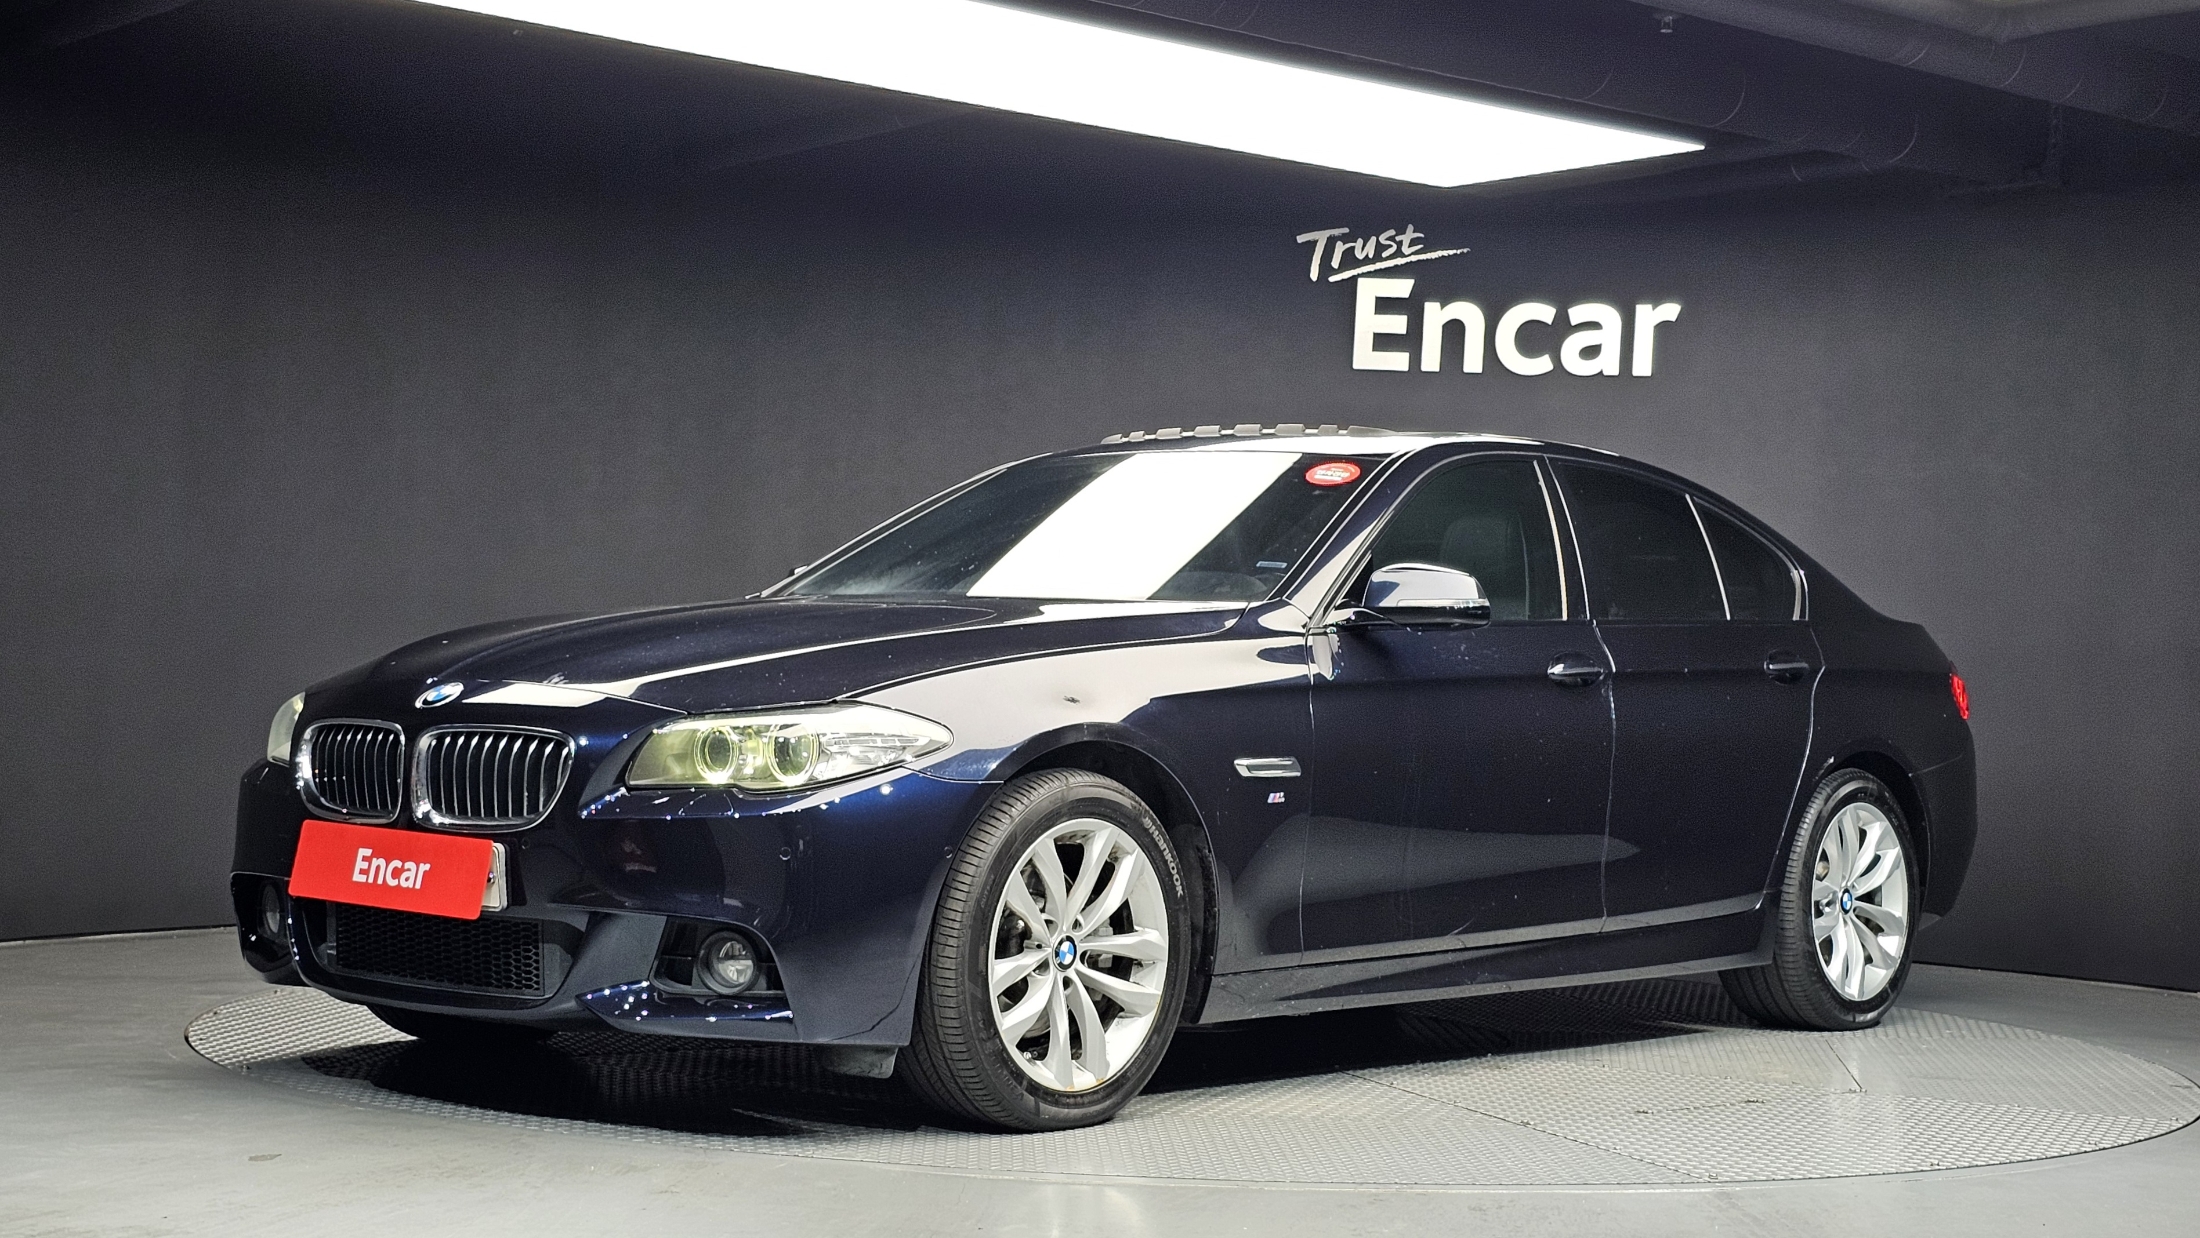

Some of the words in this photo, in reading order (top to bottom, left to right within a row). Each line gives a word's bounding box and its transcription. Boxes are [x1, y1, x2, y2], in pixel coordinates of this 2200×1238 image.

[1296, 223, 1425, 282] Trust
[1351, 277, 1683, 378] Encar
[351, 847, 431, 890] Encar
